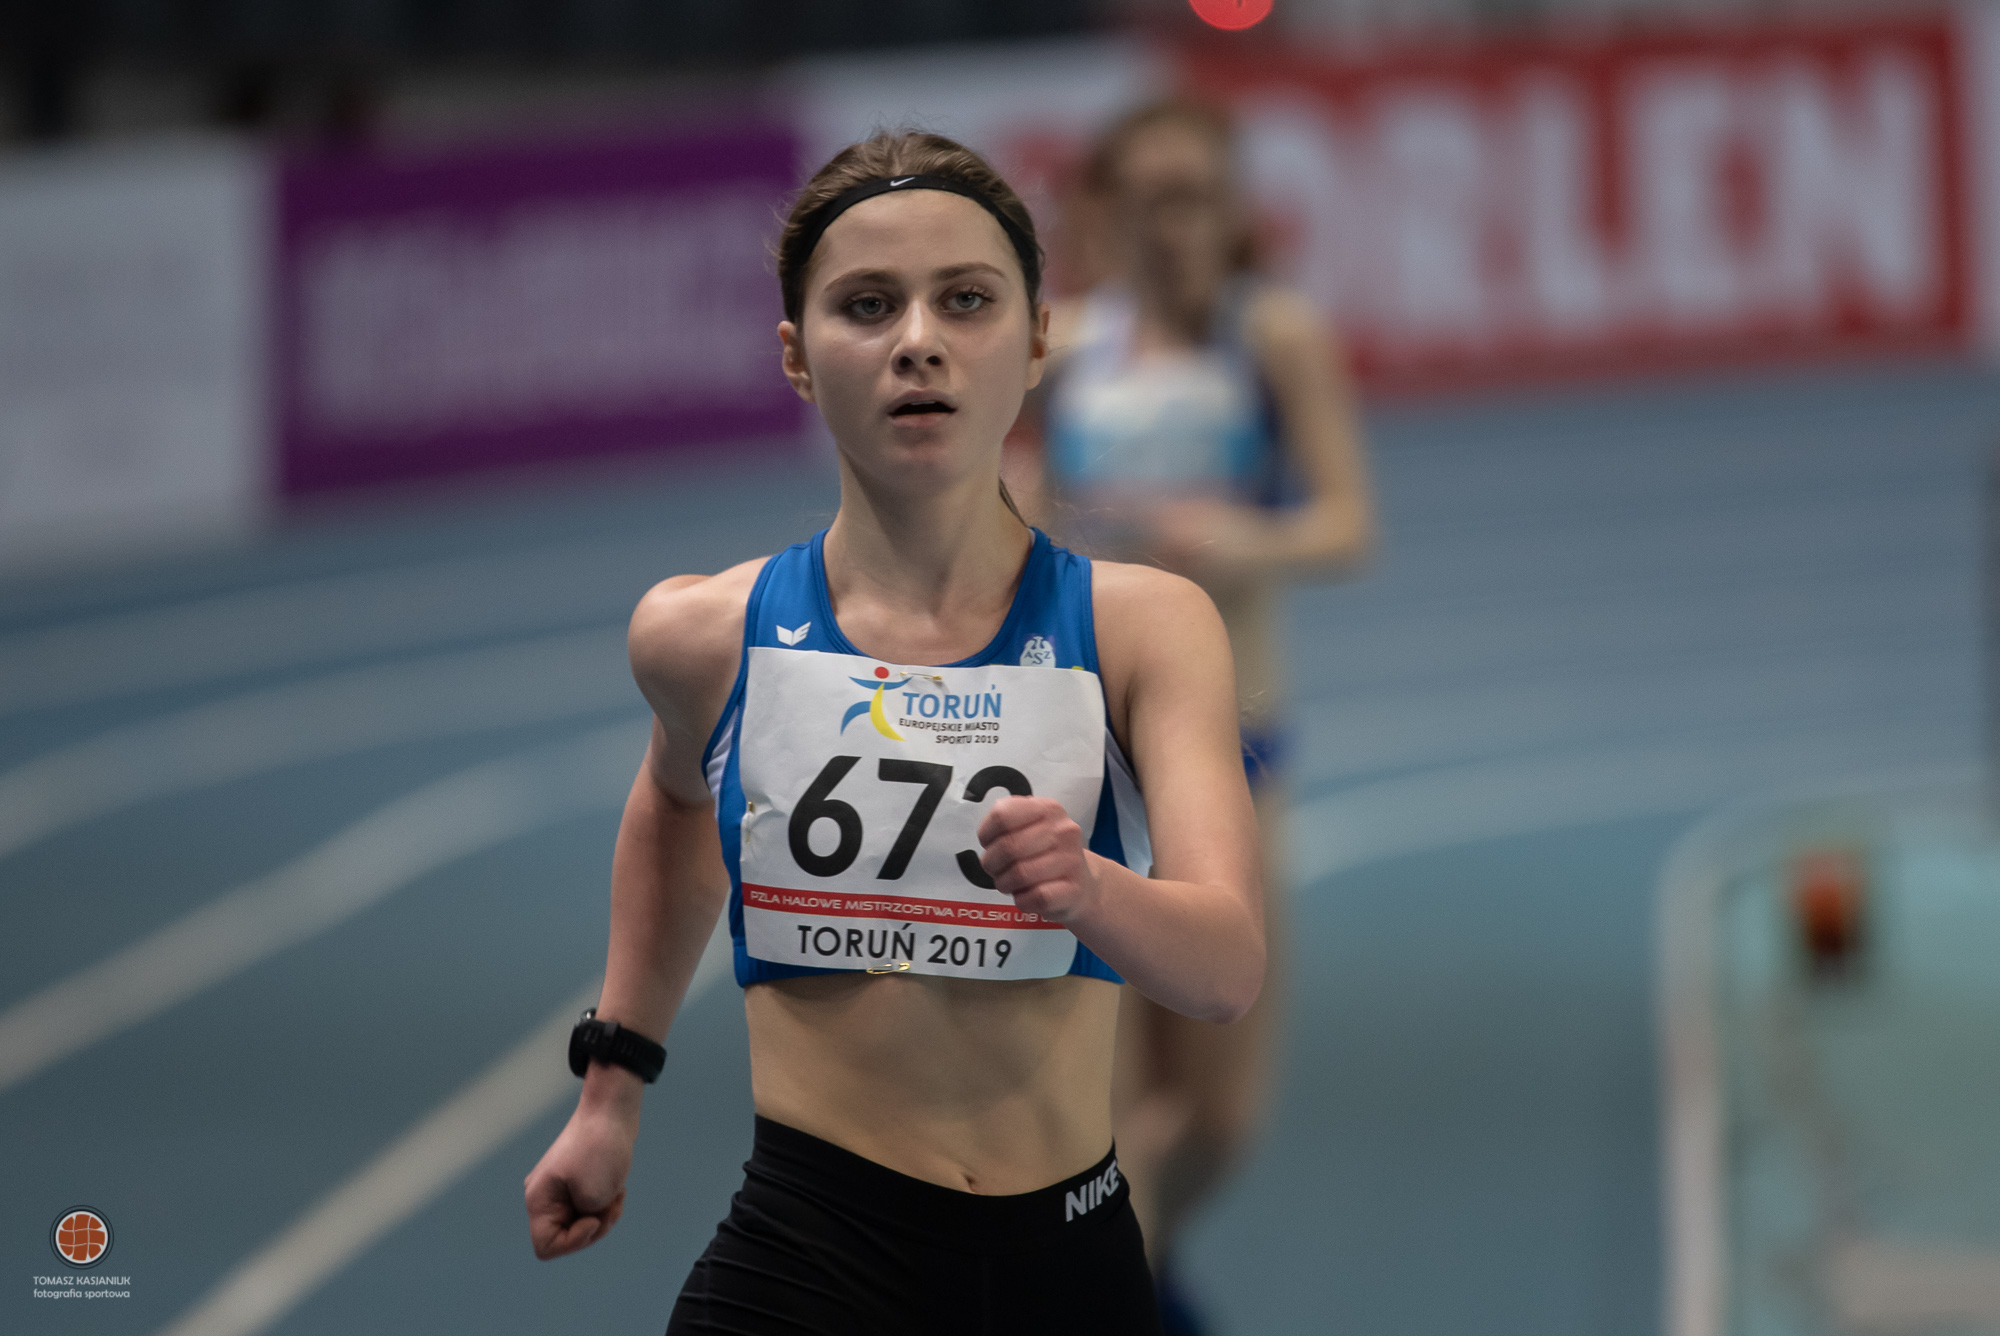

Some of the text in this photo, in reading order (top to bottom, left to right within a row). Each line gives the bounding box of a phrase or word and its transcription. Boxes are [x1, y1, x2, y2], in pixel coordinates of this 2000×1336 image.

[902, 684, 1002, 719] TORUŃ
[899, 718, 1000, 732] EUROPEJSKIE MIASTO
[935, 735, 999, 744] SPORTU 2019
[750, 890, 780, 905] PZLA
[782, 895, 842, 909] HALOWE
[844, 900, 955, 917] MISTRZOSTWA
[957, 908, 1011, 922] POLSKI
[1013, 912, 1039, 922] U18
[797, 922, 1012, 968] TORUŃ 2019
[1065, 1159, 1120, 1222] NIKE
